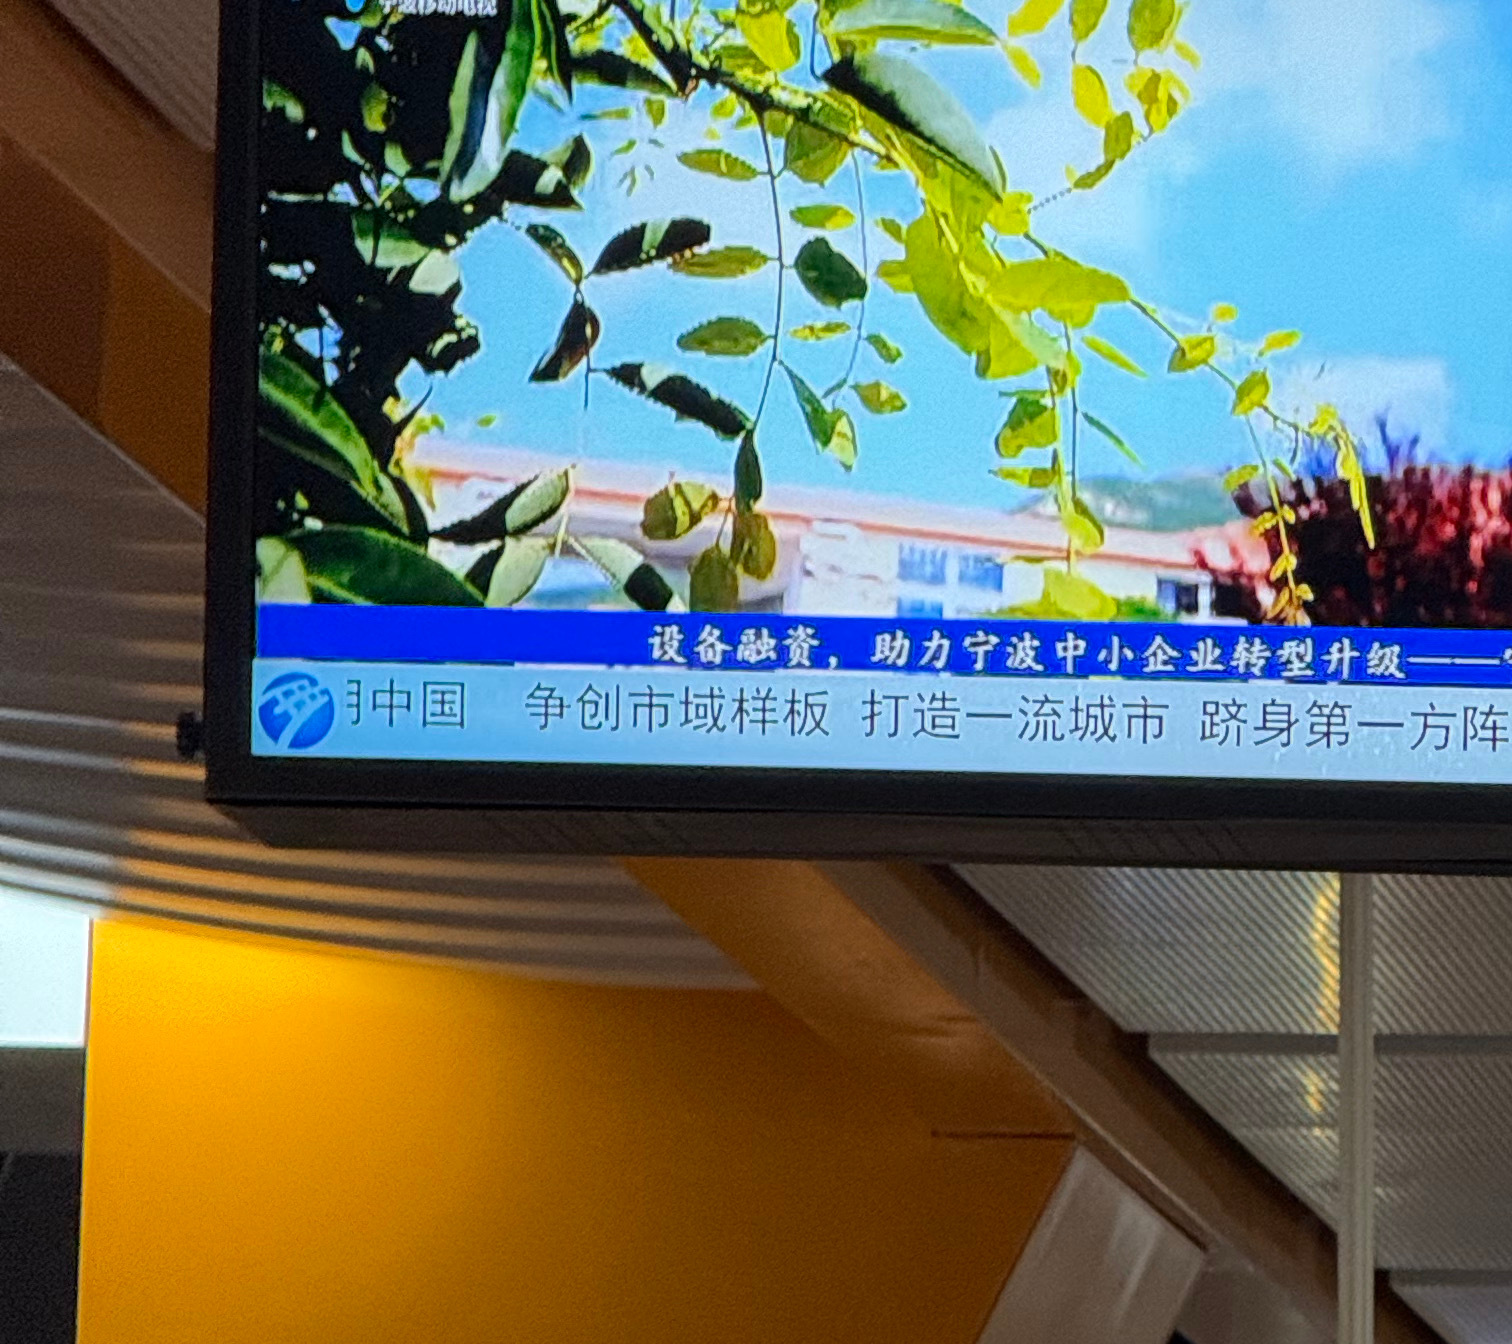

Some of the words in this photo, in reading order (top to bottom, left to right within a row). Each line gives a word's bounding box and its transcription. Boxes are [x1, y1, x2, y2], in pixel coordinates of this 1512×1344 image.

[524, 682, 831, 739] 争创市域样板
[862, 688, 1169, 744] 打造一流城市
[1200, 698, 1509, 752] 跻身第一方阵
